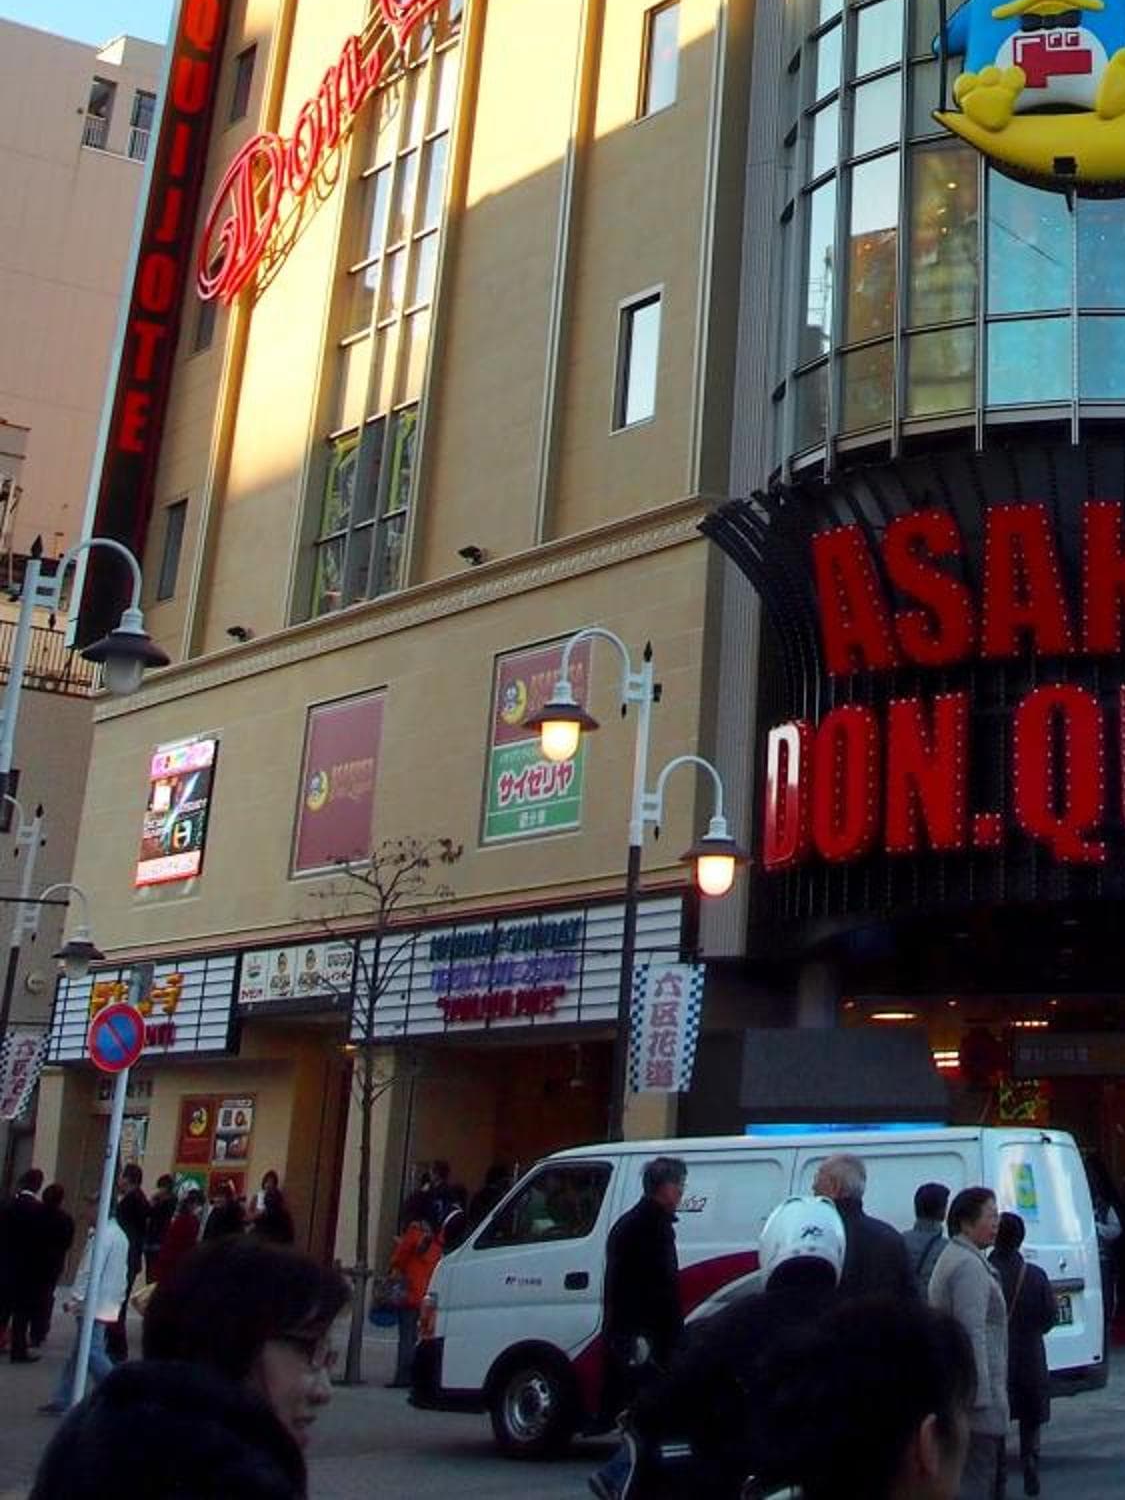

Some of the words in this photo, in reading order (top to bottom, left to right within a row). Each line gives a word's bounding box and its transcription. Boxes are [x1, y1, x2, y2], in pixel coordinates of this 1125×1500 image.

[499, 762, 573, 804] サイゼリヤ
